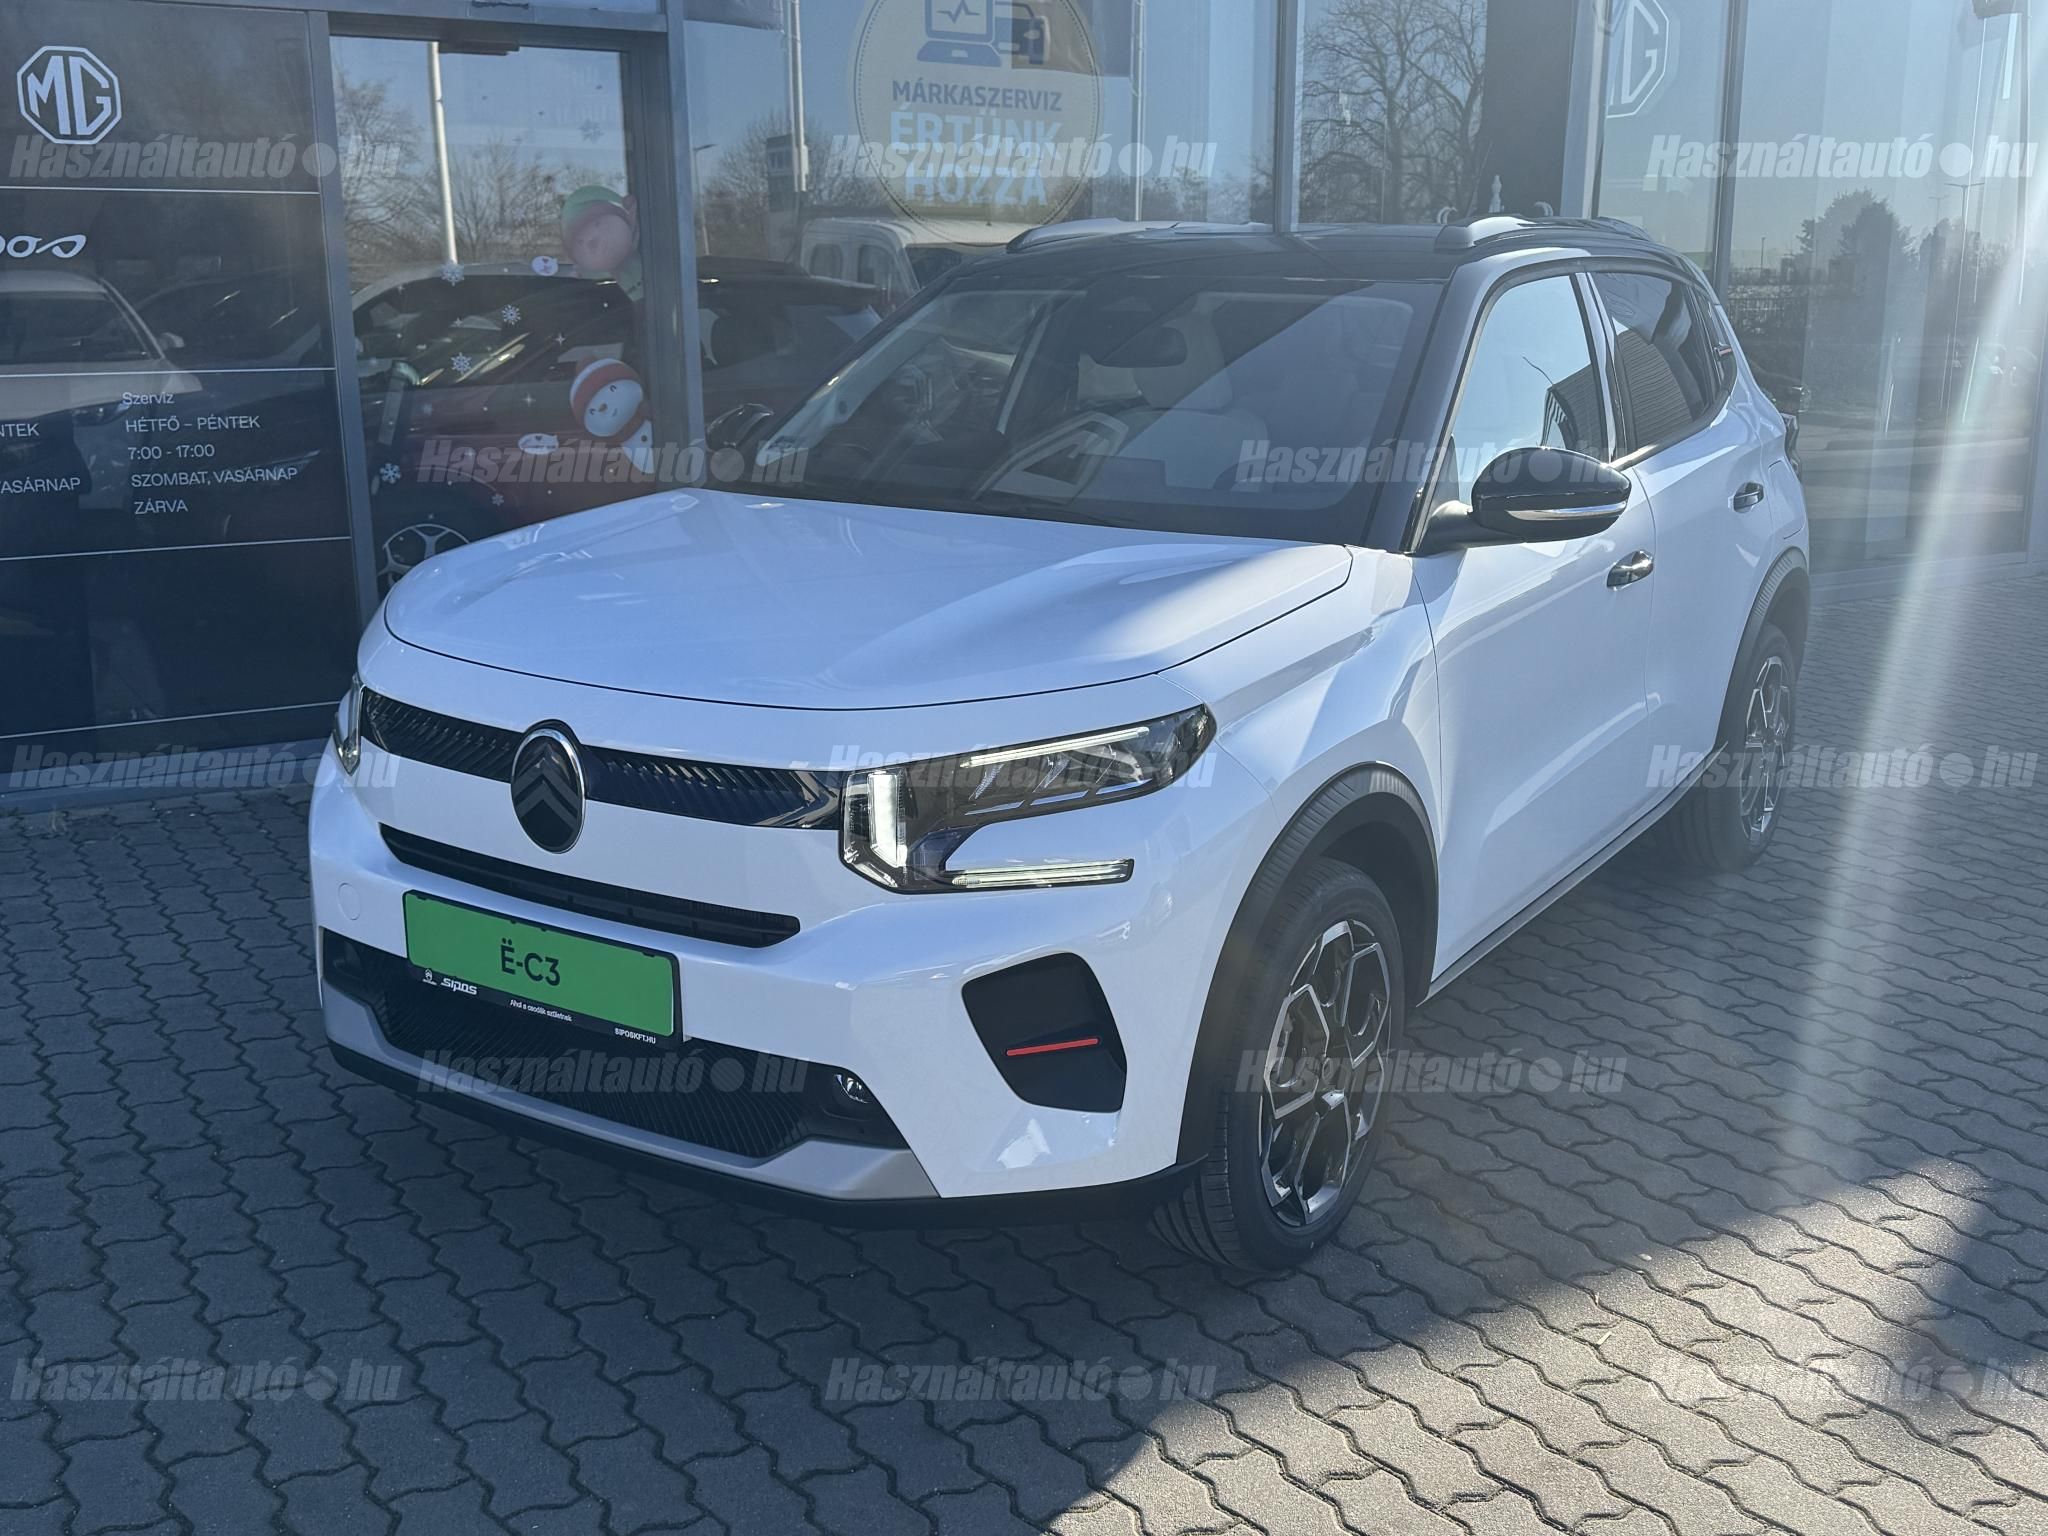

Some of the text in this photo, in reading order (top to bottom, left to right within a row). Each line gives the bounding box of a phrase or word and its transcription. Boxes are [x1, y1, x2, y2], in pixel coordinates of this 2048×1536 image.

[26, 54, 111, 136] MG
[891, 77, 1063, 111] MÁRKASZERVIZ
[890, 102, 1064, 161] ÉRTÜNK
[121, 392, 175, 406] Szerviz
[125, 414, 181, 433] HÉTFŐ
[196, 413, 261, 431] PÉNTEK
[127, 446, 162, 461] 7:00
[175, 444, 216, 459] 17:00
[0, 476, 81, 494] ASÁRNAP
[130, 465, 298, 489] SZOMBAT, VASÁRNAP
[134, 499, 189, 516] ZÁRVA
[500, 937, 561, 987] Ë-C3
